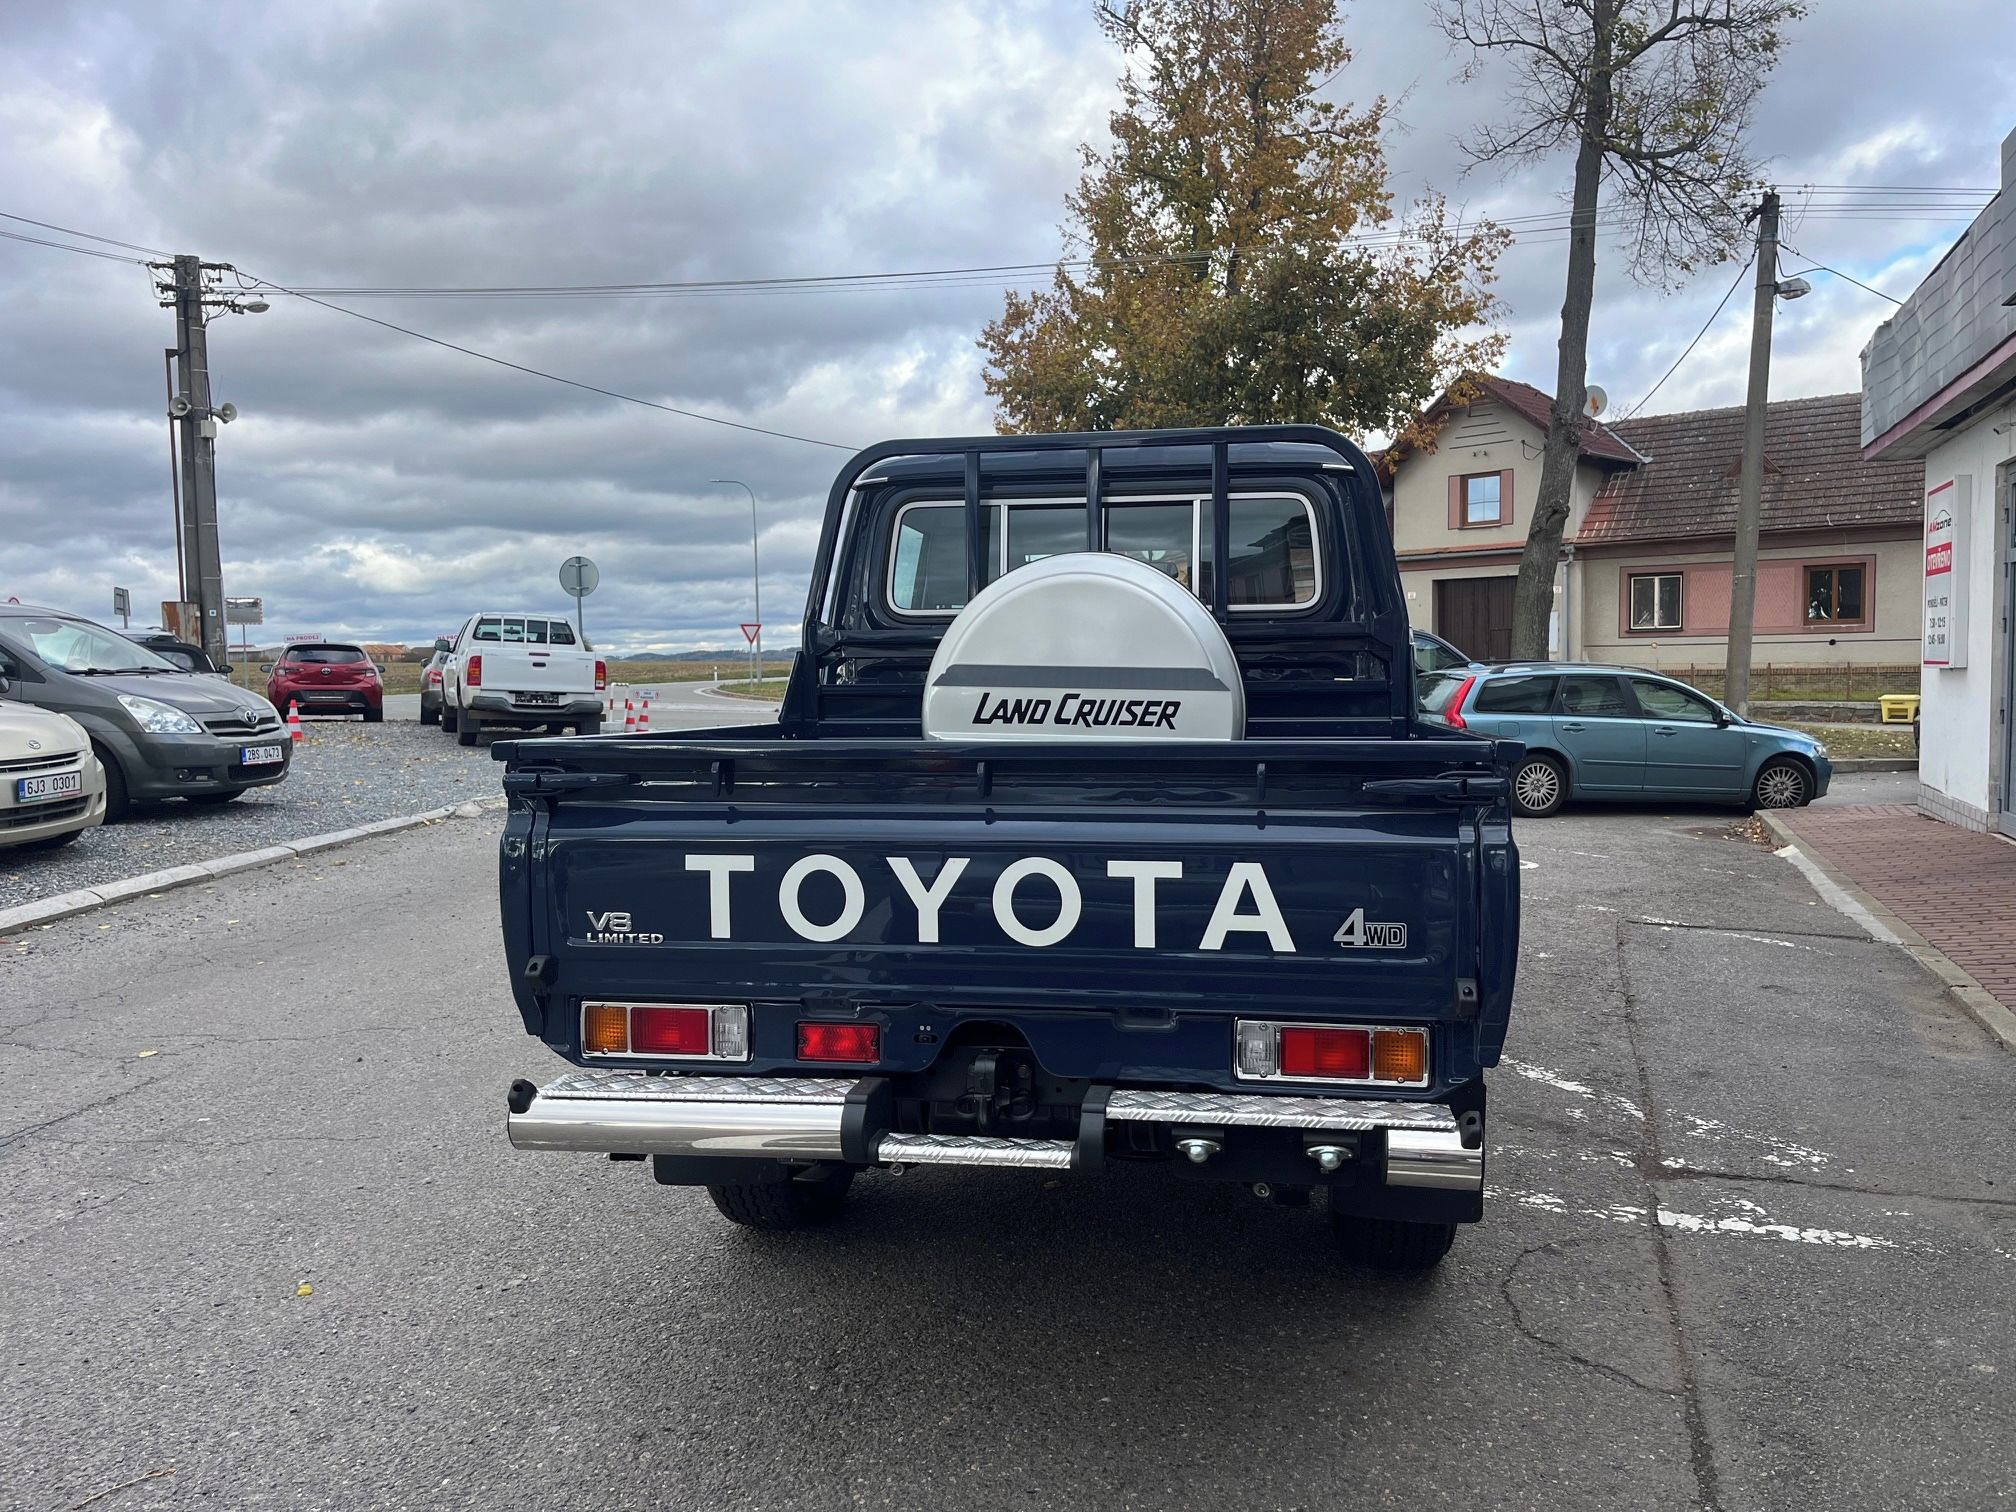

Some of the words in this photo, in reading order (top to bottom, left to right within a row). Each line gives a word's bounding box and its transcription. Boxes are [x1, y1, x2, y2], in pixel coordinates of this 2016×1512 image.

[1927, 547, 1951, 571] OTEVŘENO
[972, 692, 1052, 725] LAND
[1054, 693, 1181, 730] CRUISER
[247, 749, 260, 761] 2BS
[264, 747, 280, 759] 0473
[27, 779, 46, 795] 6J3
[52, 774, 77, 791] 0301
[684, 853, 1296, 952] TOYOTA
[586, 911, 632, 932] V8
[1333, 907, 1407, 949] 4WD
[586, 932, 664, 944] LIMITED
